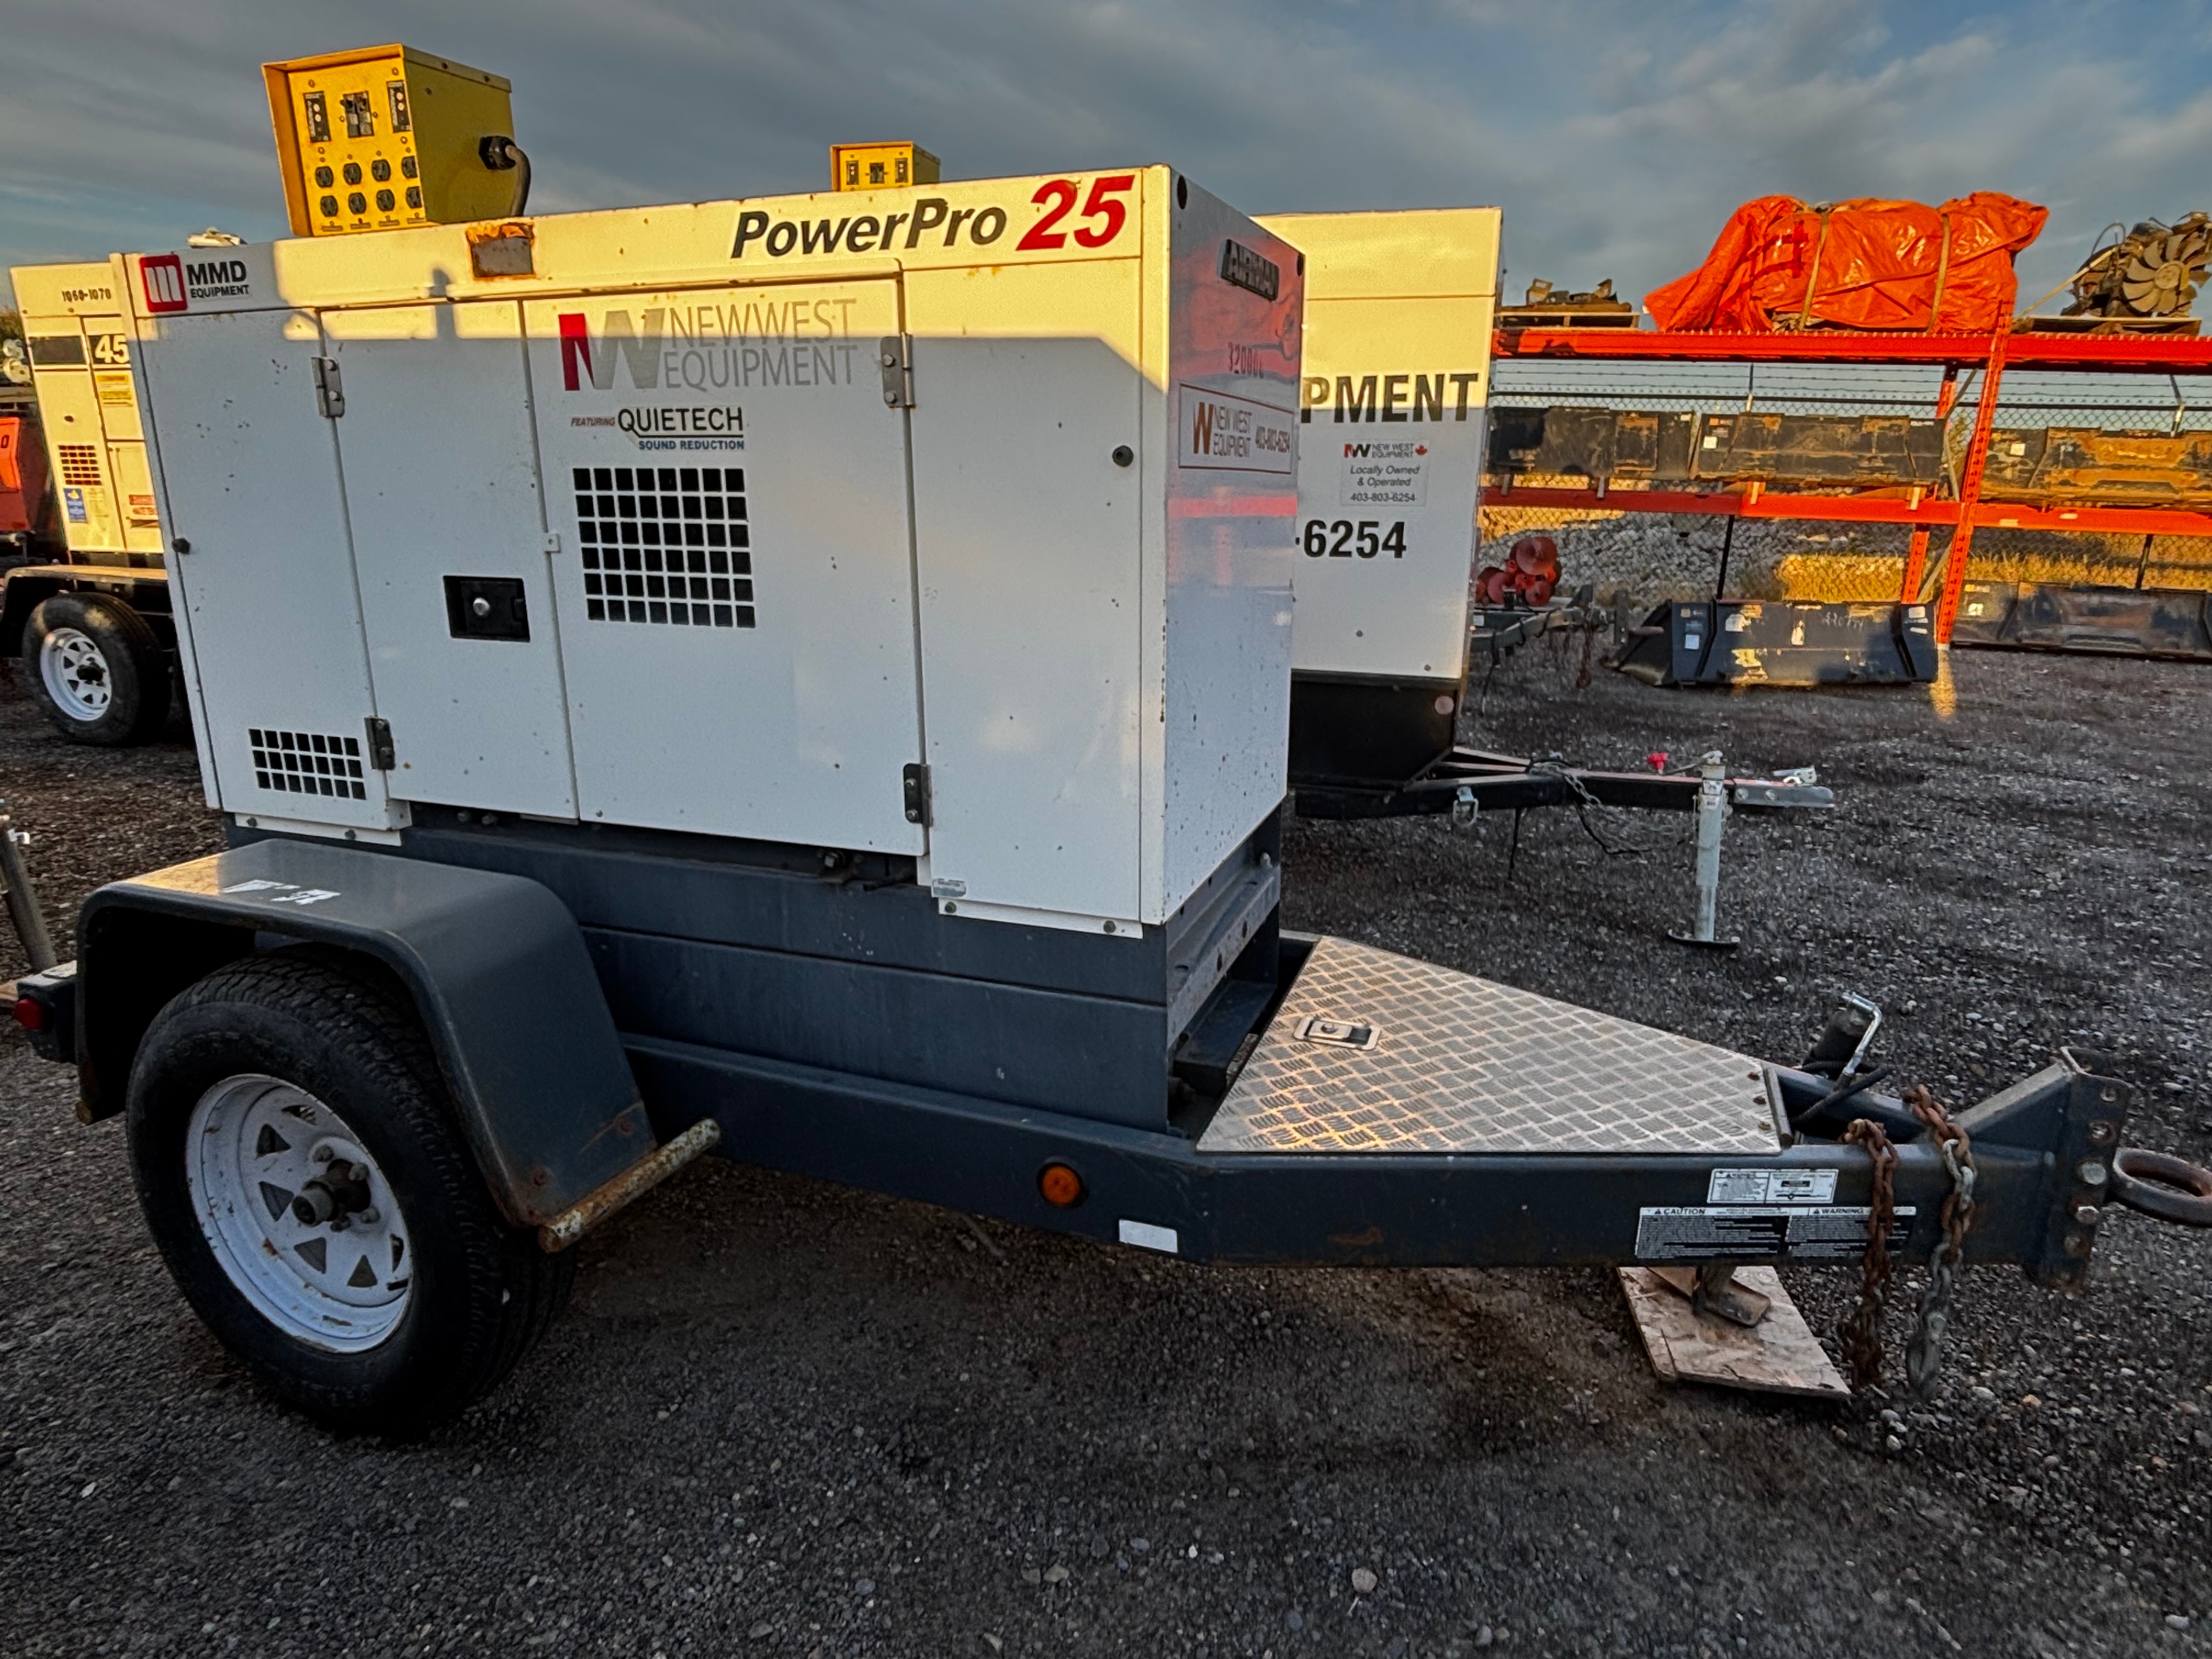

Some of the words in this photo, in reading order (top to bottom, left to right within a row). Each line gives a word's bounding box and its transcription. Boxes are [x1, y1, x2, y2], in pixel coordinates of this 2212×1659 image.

[731, 198, 1007, 259] PowerPro
[1015, 174, 1136, 252] 25
[186, 260, 247, 285] MMD
[190, 285, 250, 299] EQUIPMENT
[94, 334, 130, 363] 45
[663, 345, 858, 392] EQUIPMENT
[1301, 373, 1479, 423] PMENT
[571, 416, 616, 427] FEATURING
[617, 406, 744, 434] QUIETECH
[639, 440, 677, 451] SOUND
[680, 440, 745, 451] REDUCTION
[1372, 443, 1390, 451] NEW
[1391, 443, 1414, 451] WEST
[1350, 464, 1384, 476] Locally
[1386, 464, 1421, 475] Owned
[1357, 477, 1364, 486] &
[1367, 477, 1412, 488] Operated
[1350, 492, 1416, 503] 403-803-6254
